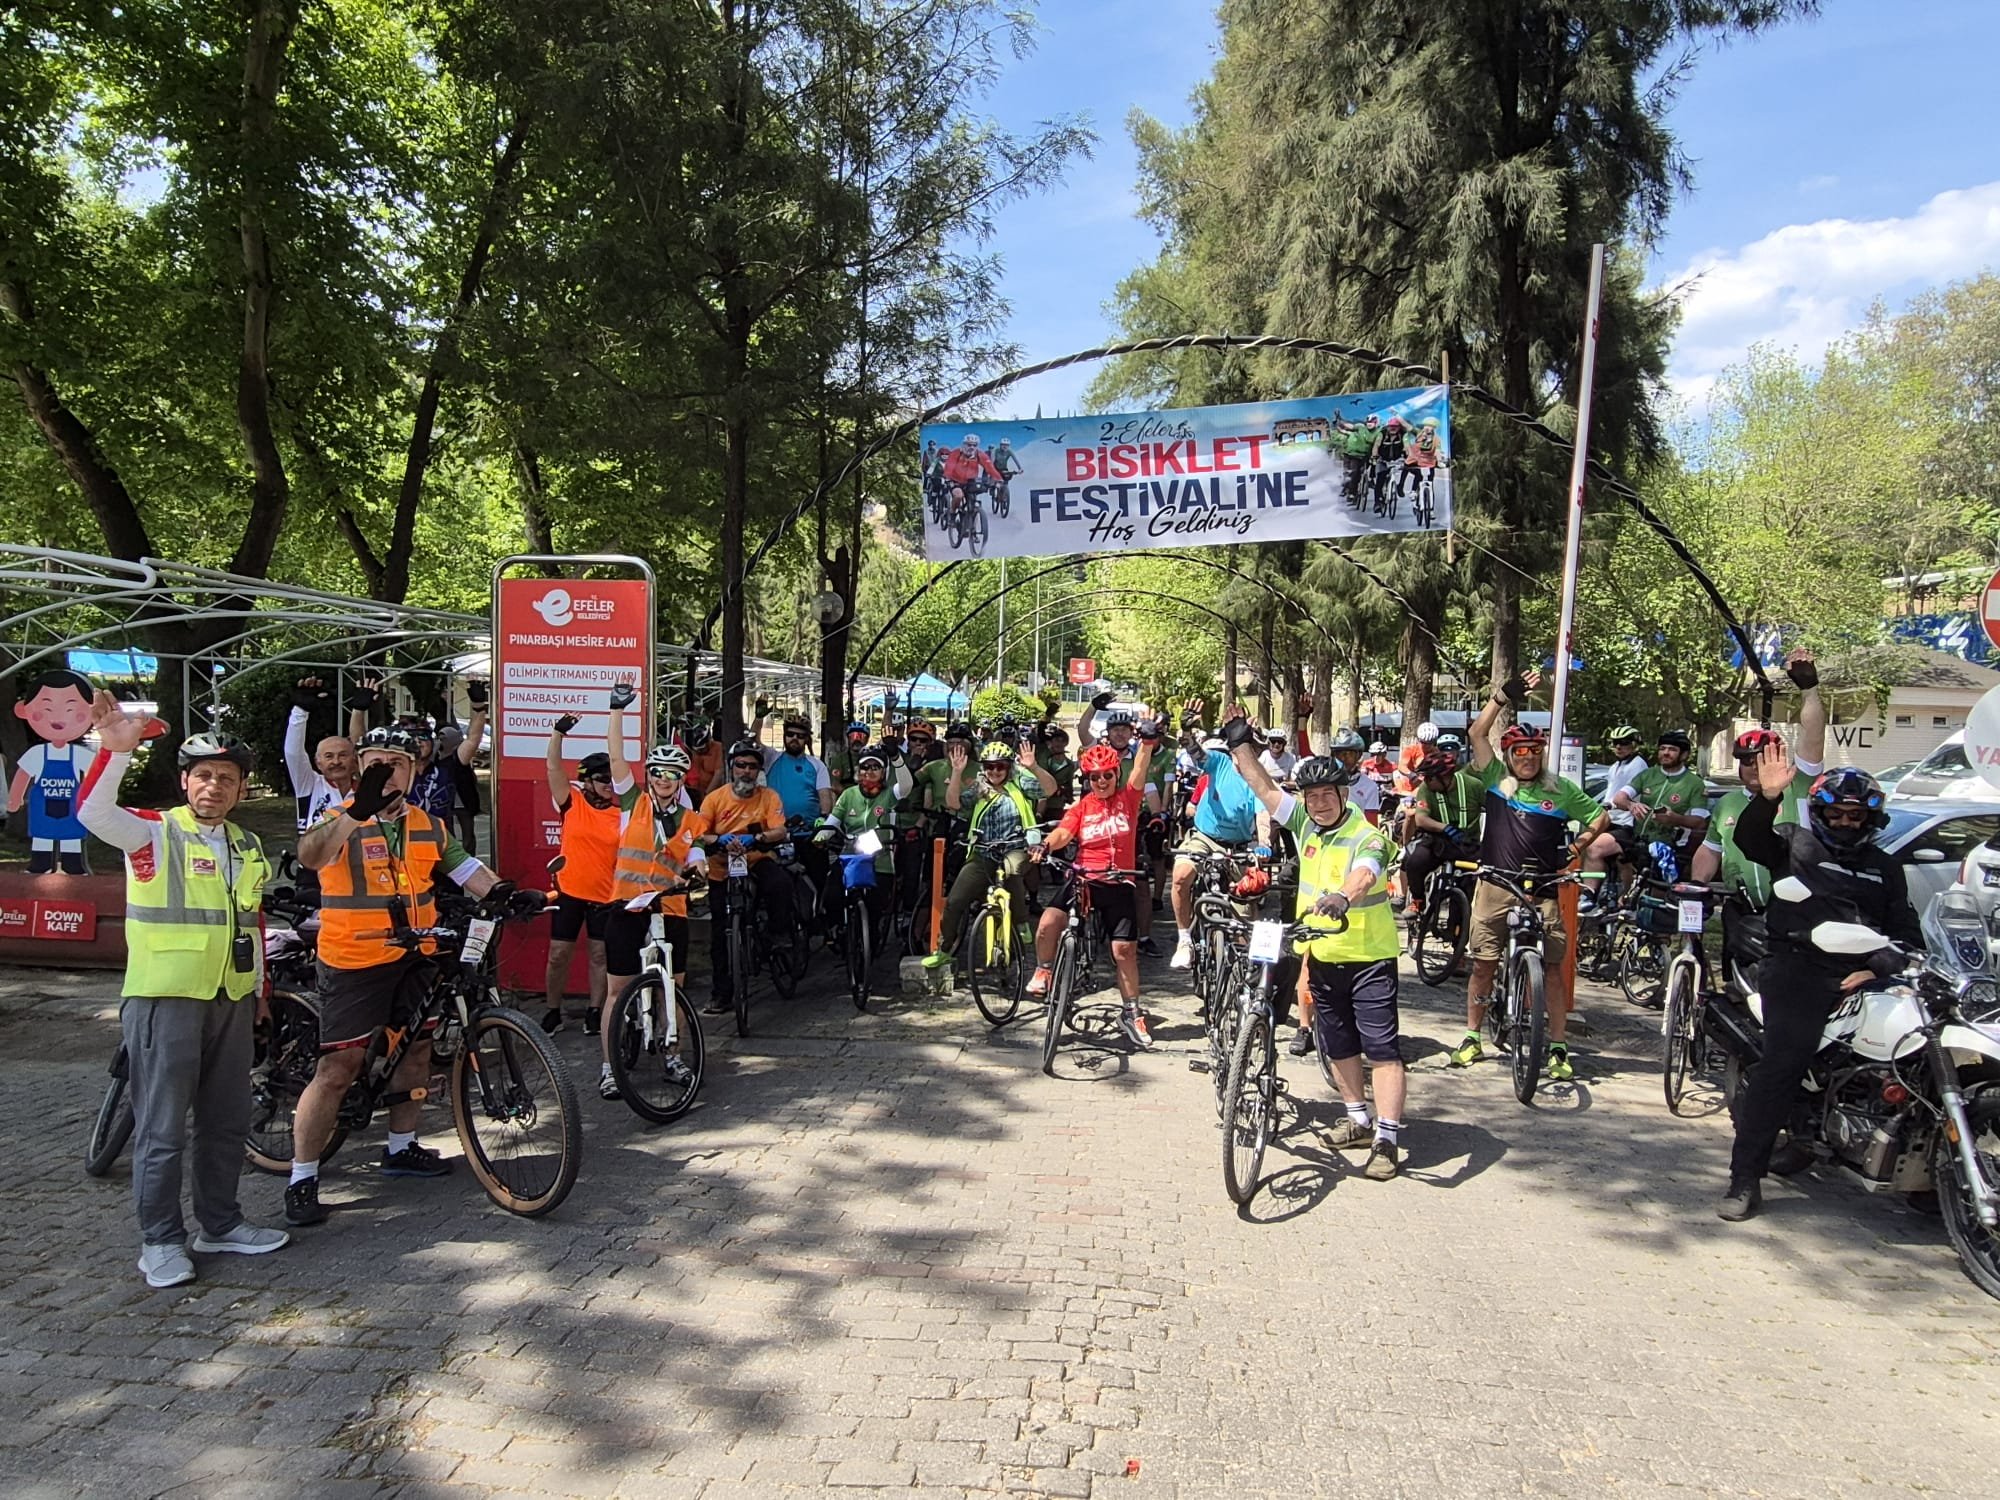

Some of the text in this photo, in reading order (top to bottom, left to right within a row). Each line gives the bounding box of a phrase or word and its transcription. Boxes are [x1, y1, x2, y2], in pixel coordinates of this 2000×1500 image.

[1089, 505, 1257, 545] Hoş Geldiniz
[573, 599, 615, 612] EFELER
[509, 634, 637, 648] PINARBAŞI MESİRE ALANI
[508, 666, 549, 680] OLİMPİK
[551, 669, 598, 682] TIRMANIŞ
[508, 692, 589, 706] PINARBAŞI KAFE
[508, 717, 539, 727] DOWN
[1832, 726, 1874, 748] WC
[40, 777, 76, 788] DOWN
[43, 788, 72, 798] KAFE
[44, 910, 83, 923] DOWN
[47, 920, 78, 933] KAFE
